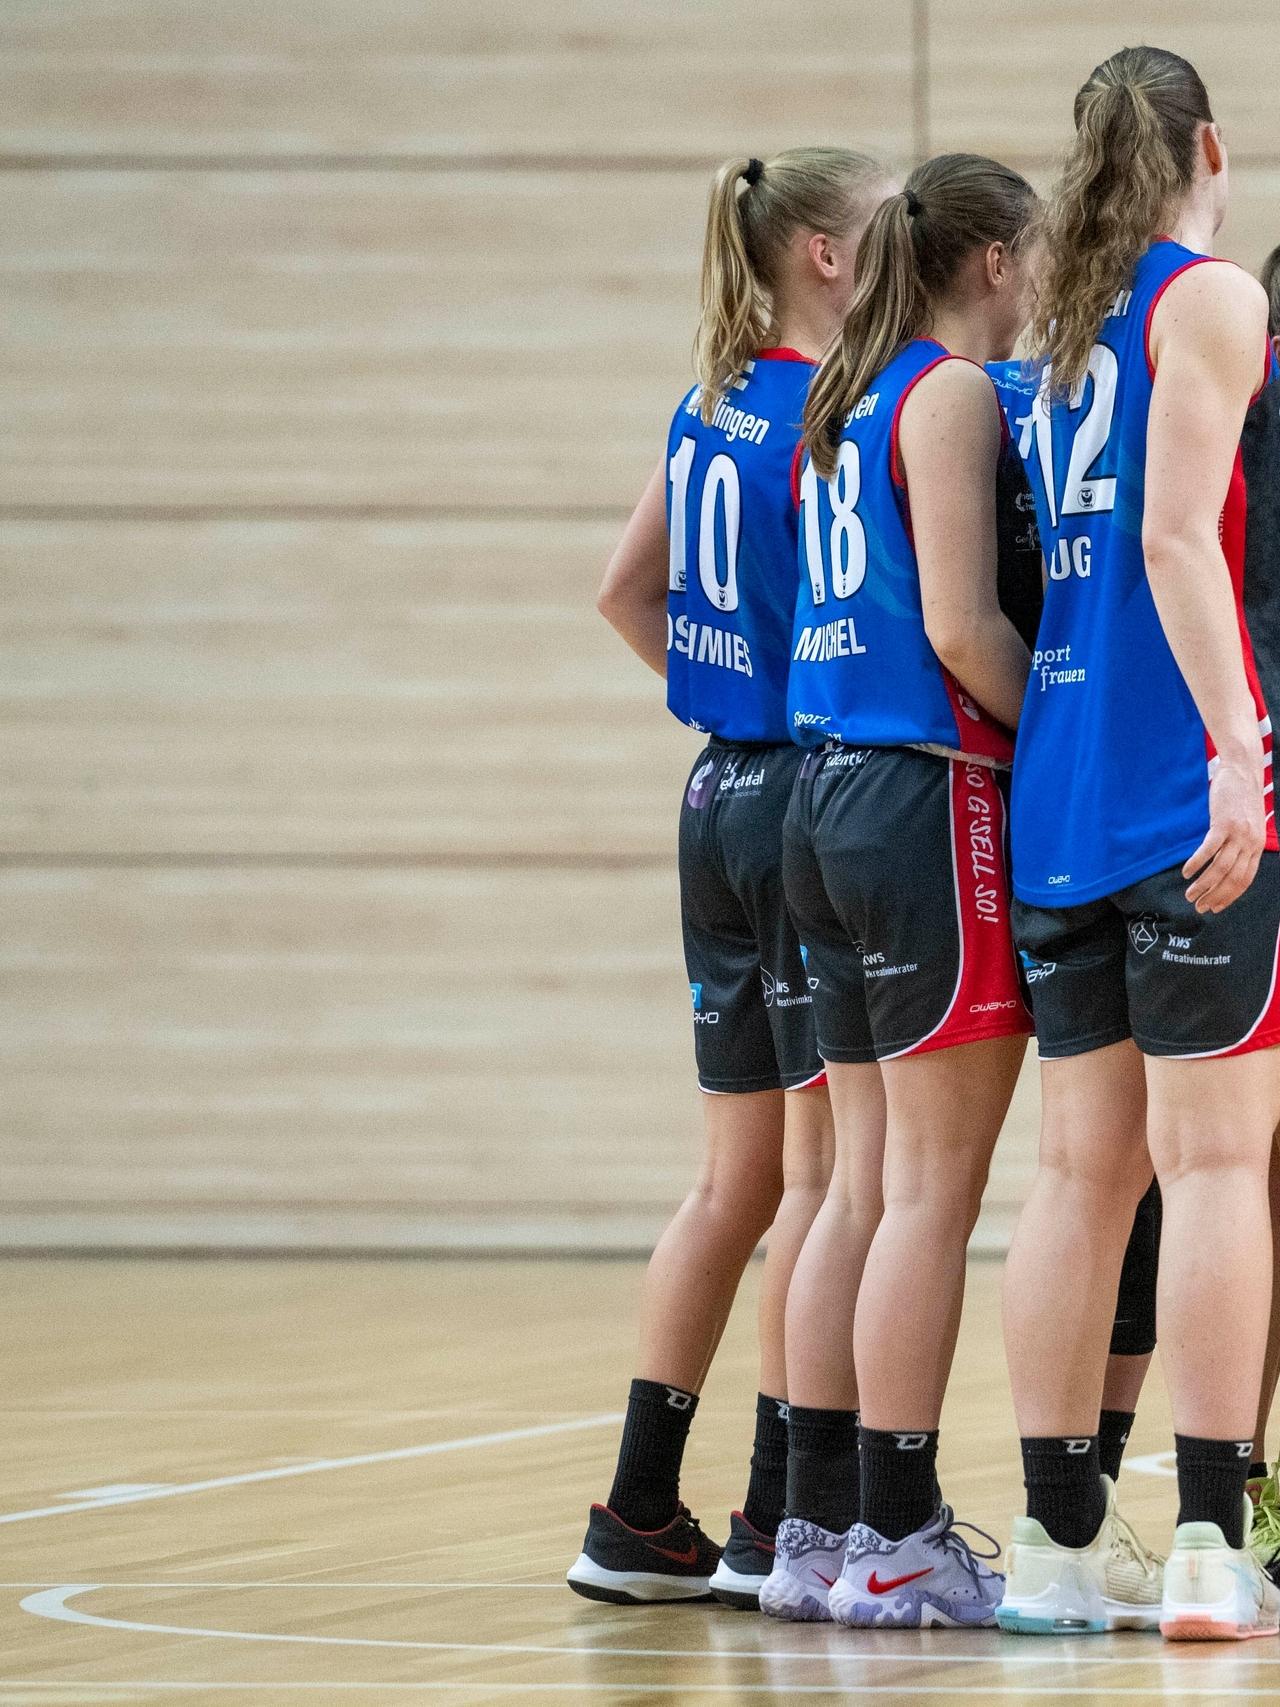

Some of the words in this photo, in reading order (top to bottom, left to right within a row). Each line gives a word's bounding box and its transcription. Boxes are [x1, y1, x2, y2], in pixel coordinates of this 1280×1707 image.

[1034, 345, 1118, 527] 12
[668, 435, 740, 611] 10
[799, 440, 866, 604] 18
[793, 617, 867, 662] MICHEL
[1032, 644, 1071, 670] port
[1040, 665, 1086, 692] frauen
[976, 884, 1000, 924] SO!
[1161, 949, 1232, 965] #kreativimkrater
